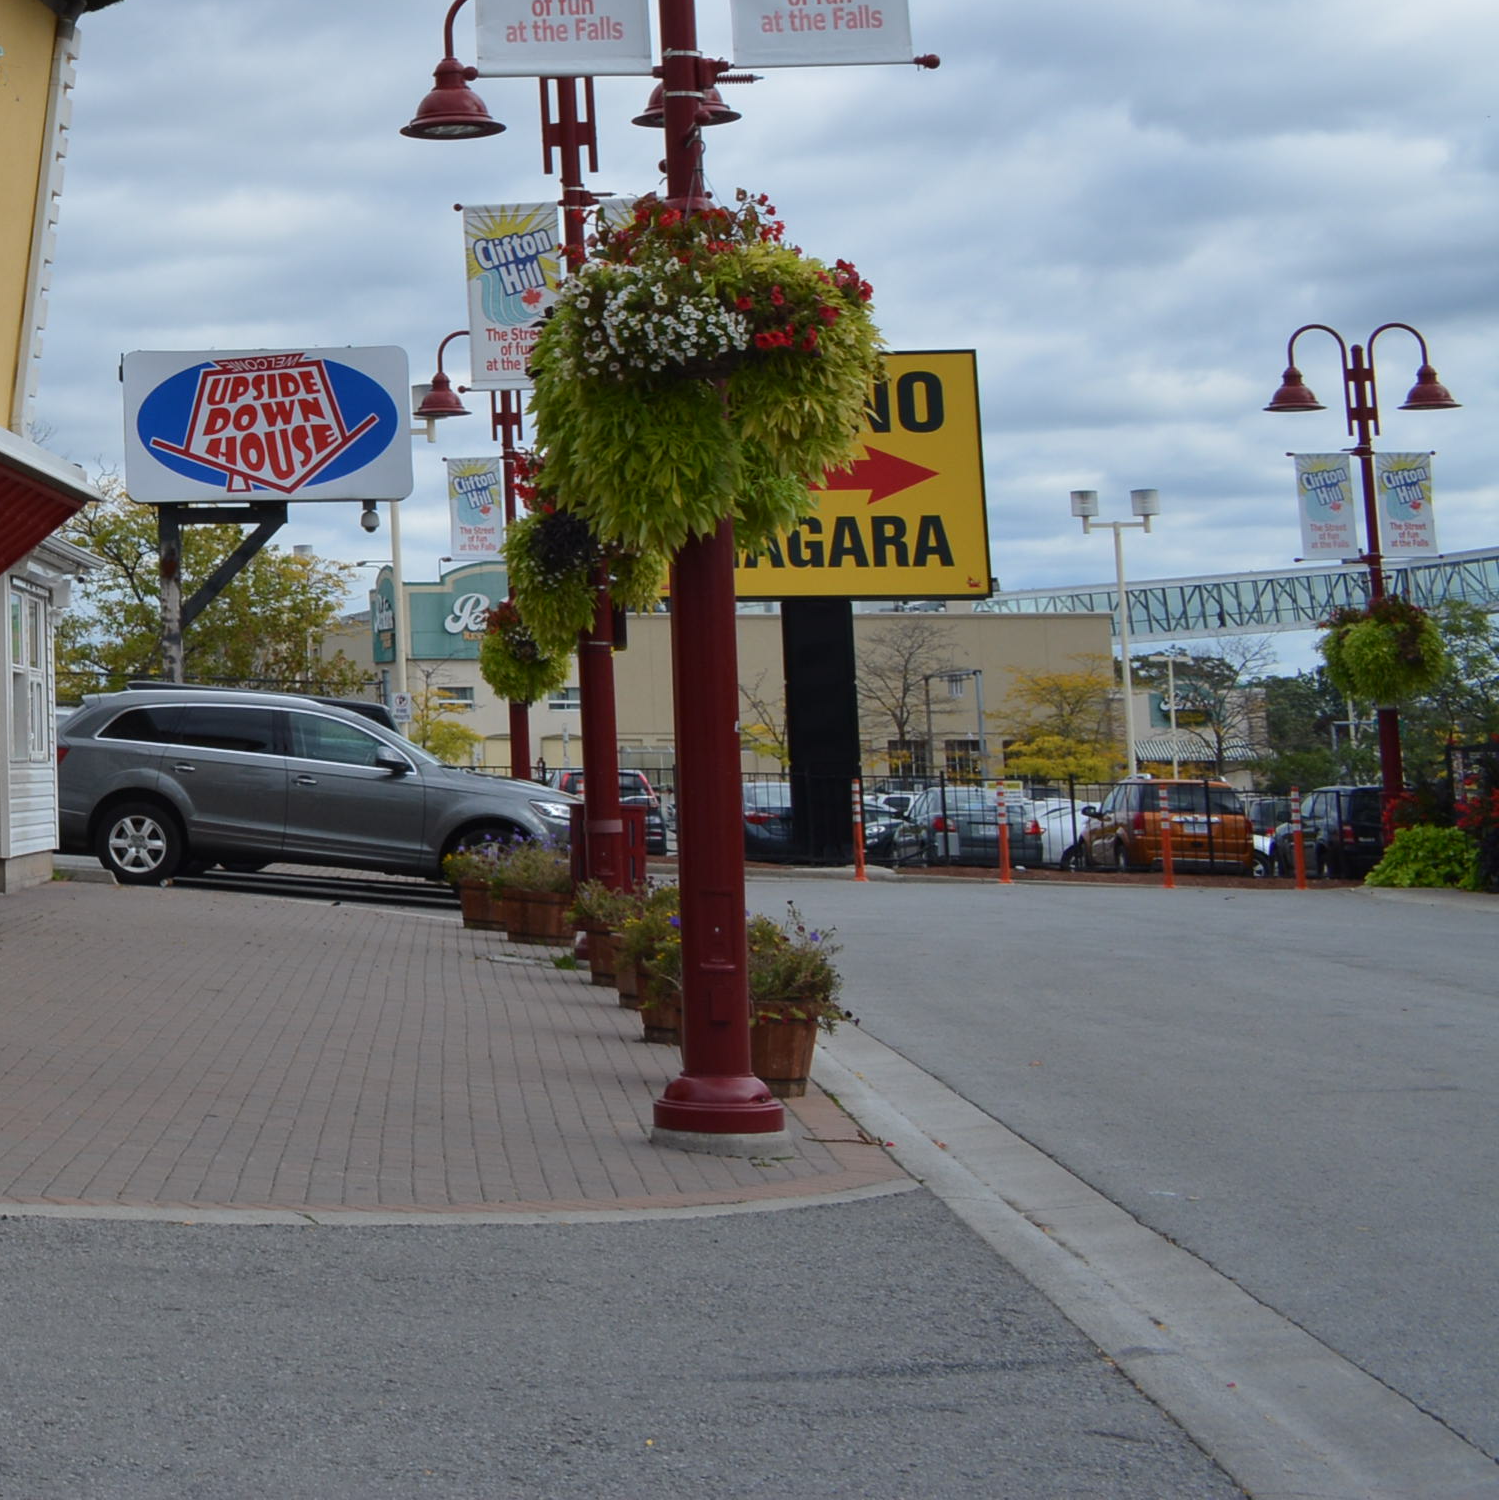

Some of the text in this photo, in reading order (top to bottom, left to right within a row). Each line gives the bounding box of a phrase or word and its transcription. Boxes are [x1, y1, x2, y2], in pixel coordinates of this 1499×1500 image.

[506, 17, 623, 43] at the Falls
[761, 5, 883, 33] at the Falls
[474, 228, 552, 270] Clifton
[498, 259, 546, 296] Hill
[485, 328, 508, 341] The
[500, 342, 513, 356] of
[219, 356, 299, 372] WELCOME
[486, 358, 499, 371] at
[501, 357, 521, 370] the
[207, 370, 321, 406] UPSIDE
[203, 397, 326, 436] DOWN
[205, 424, 339, 480] HOUSE
[454, 472, 497, 494] Clifton
[1301, 468, 1347, 491] Clifton
[1382, 467, 1427, 489] Clifton
[467, 488, 493, 509] Hill
[1315, 485, 1344, 506] Hill
[1396, 483, 1424, 505] Hill
